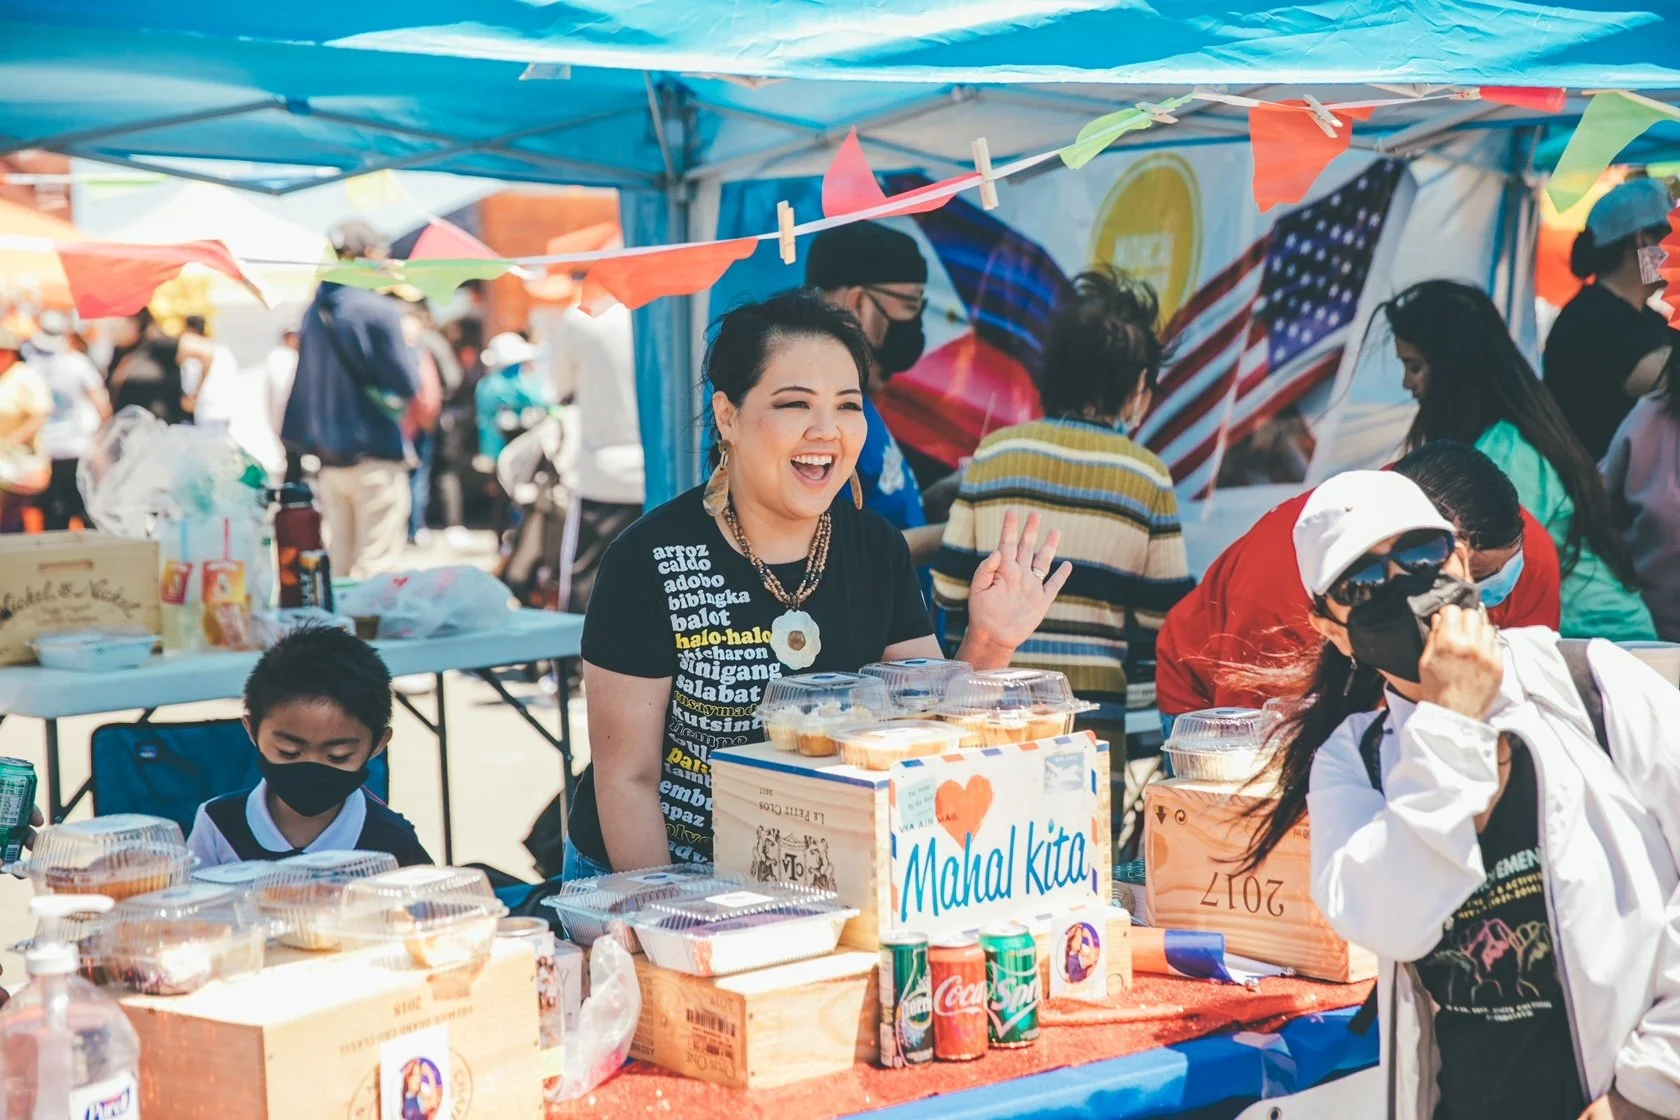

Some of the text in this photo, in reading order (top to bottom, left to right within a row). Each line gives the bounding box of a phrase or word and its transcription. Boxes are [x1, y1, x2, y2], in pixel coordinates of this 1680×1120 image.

[652, 544, 709, 560] arroz
[657, 556, 711, 574] caldo
[664, 572, 725, 593] adobo
[668, 588, 751, 611] bibingka
[670, 609, 731, 632] balot
[679, 657, 782, 685] sinigang
[676, 674, 761, 703] salabat
[672, 699, 763, 733] kutsint
[673, 690, 757, 717] ensaymad
[660, 801, 705, 828] apaz
[900, 815, 1090, 922] Mahal kita
[1200, 871, 1285, 917] 2017
